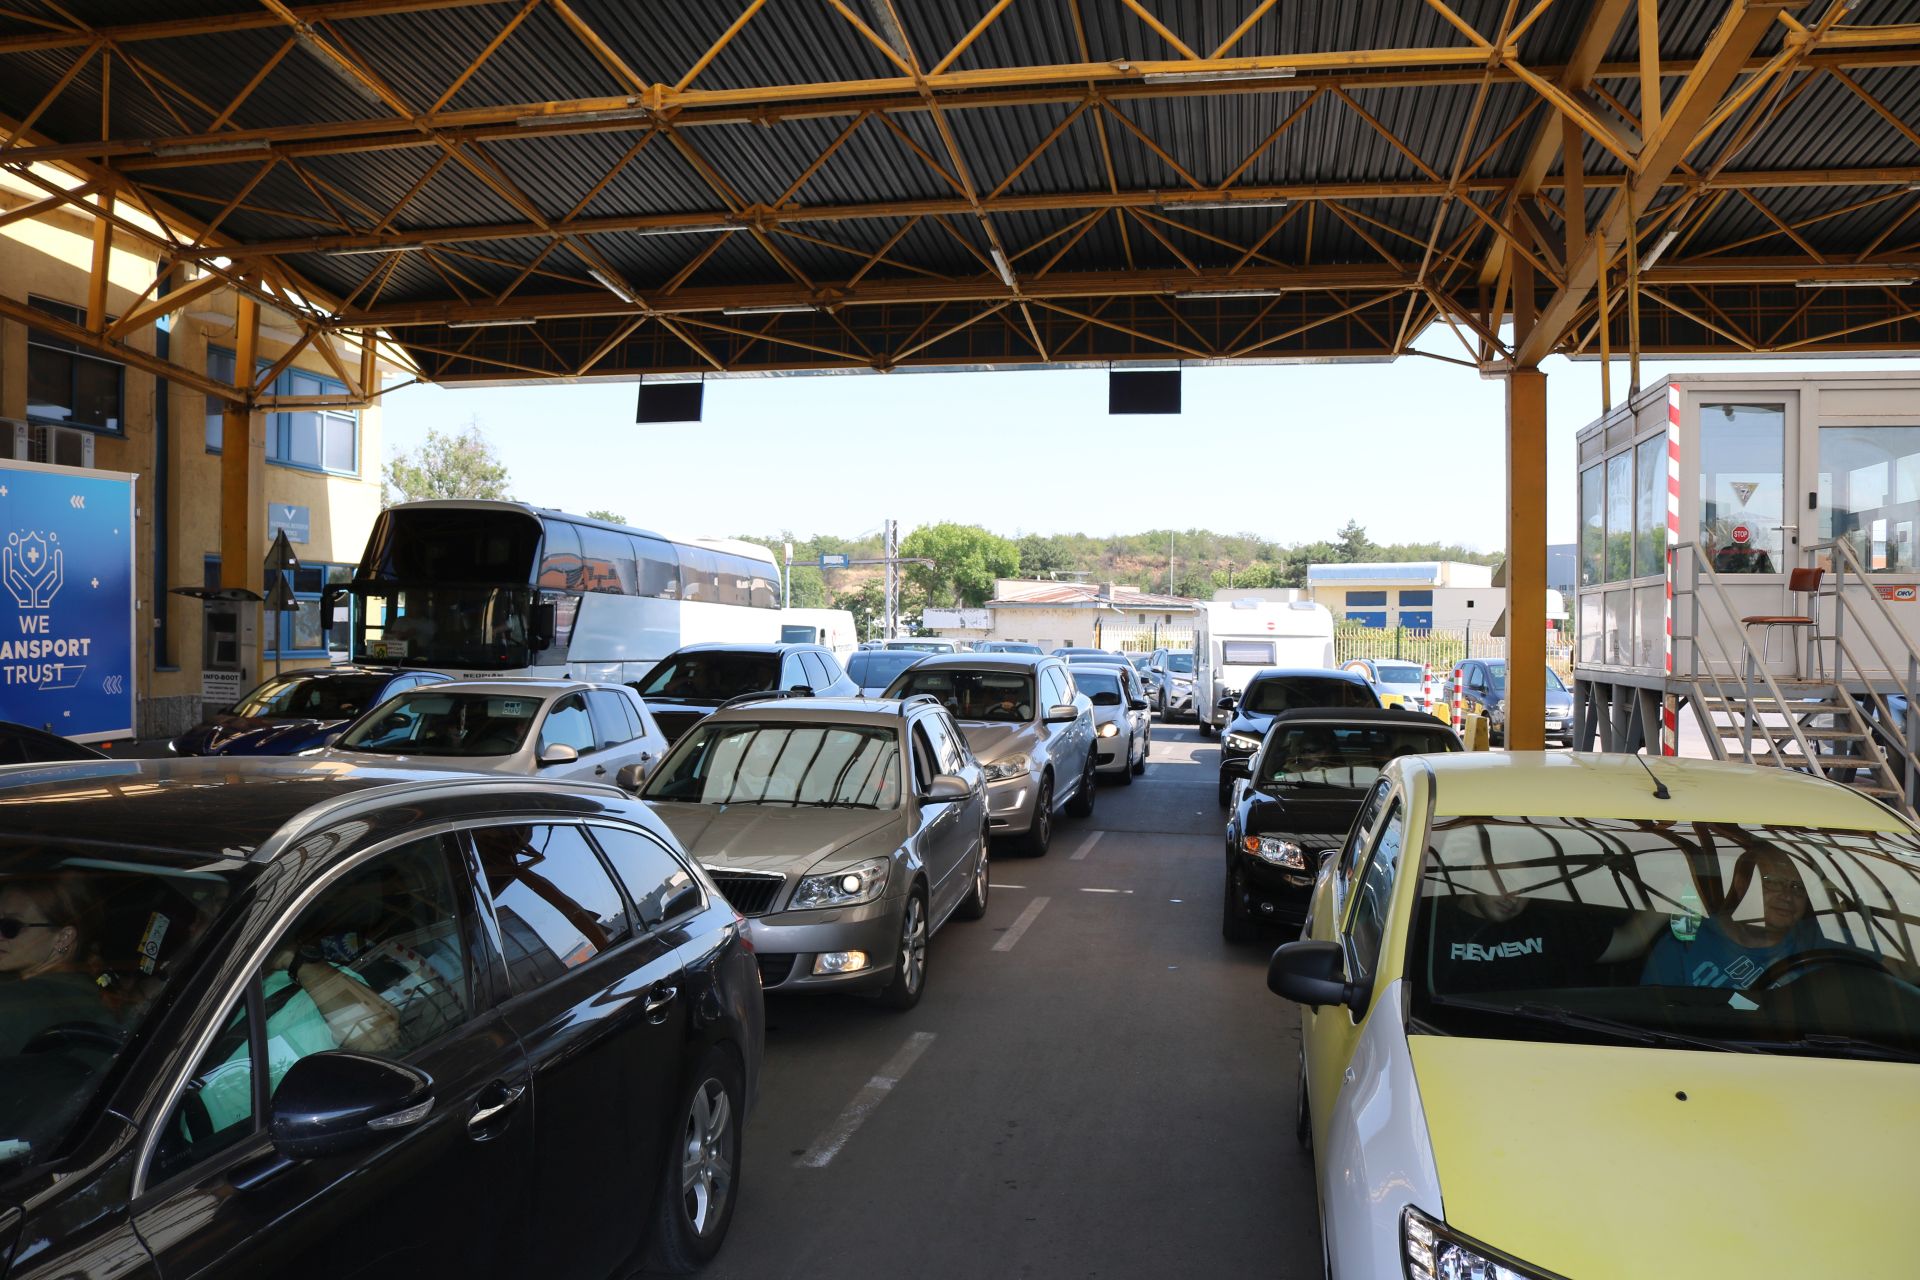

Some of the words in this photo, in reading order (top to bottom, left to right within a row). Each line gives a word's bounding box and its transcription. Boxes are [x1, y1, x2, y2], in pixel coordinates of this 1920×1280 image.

[1733, 530, 1748, 538] STOP
[19, 614, 50, 634] WE
[3, 663, 65, 685] TRUST
[1450, 937, 1543, 962] REVIEW
